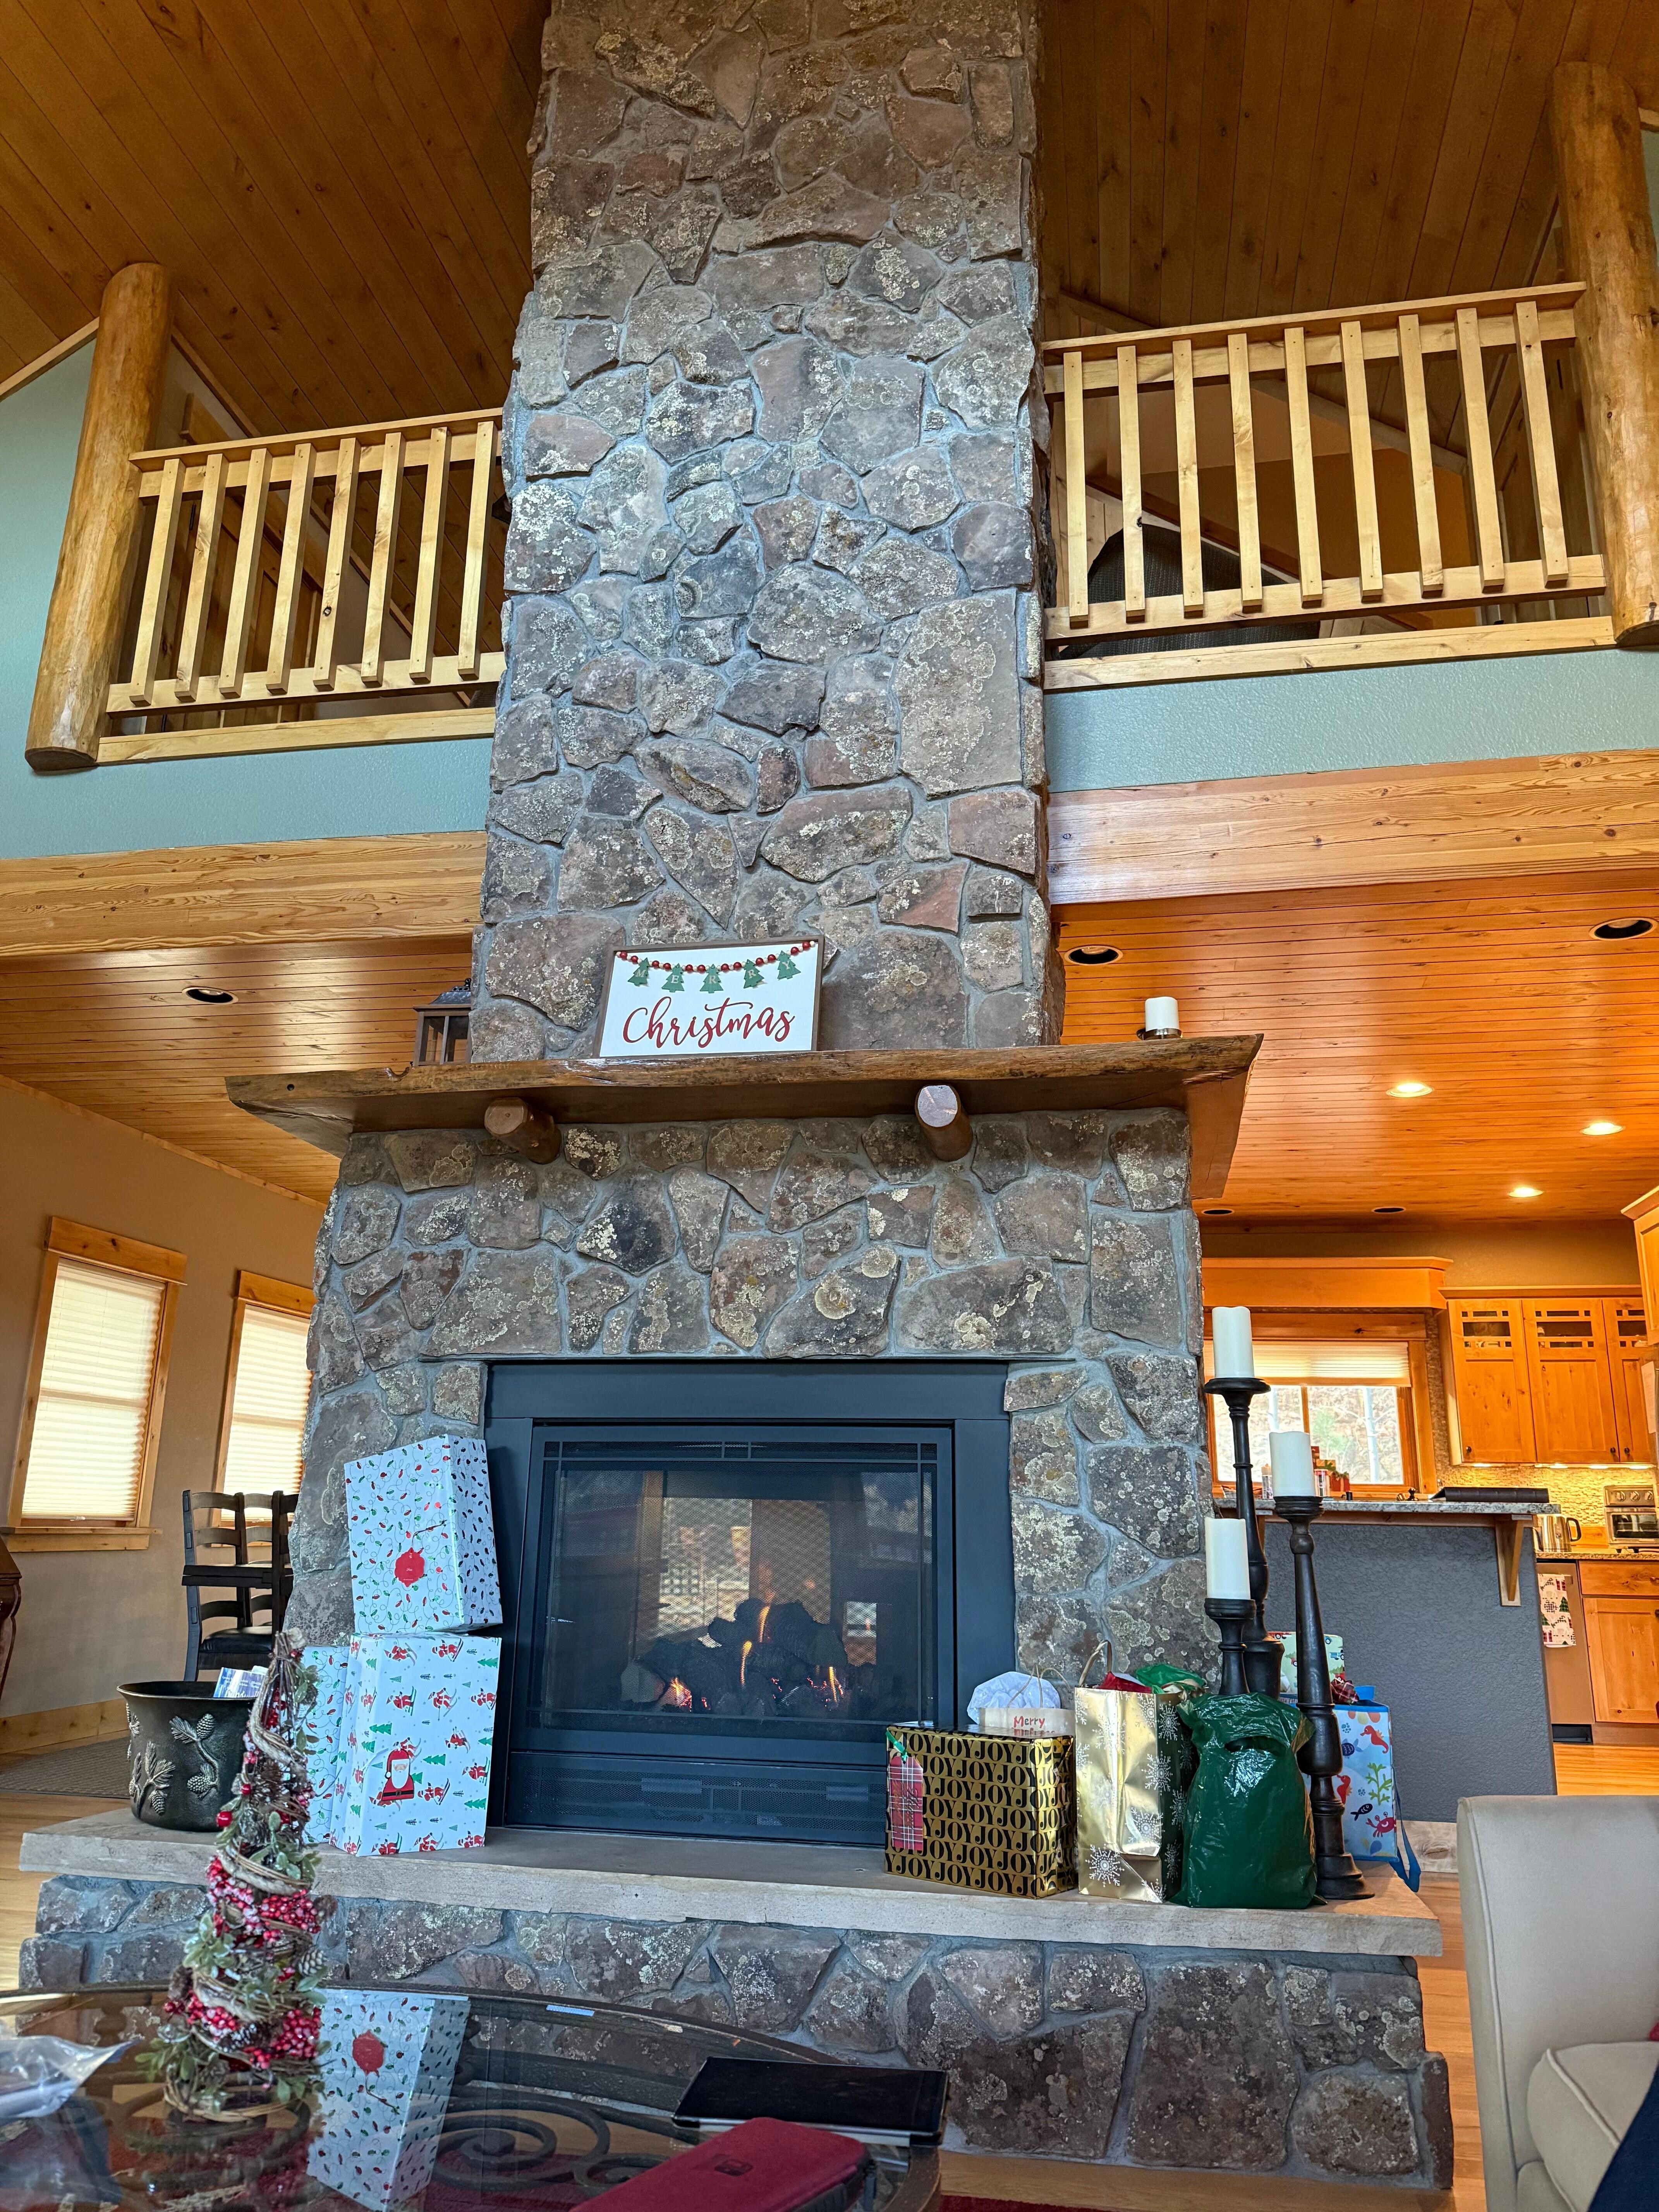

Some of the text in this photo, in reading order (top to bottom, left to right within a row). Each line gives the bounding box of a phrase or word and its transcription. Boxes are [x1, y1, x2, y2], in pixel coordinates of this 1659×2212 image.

[635, 961, 790, 984] MERRY
[623, 996, 795, 1048] Christmas
[1013, 1716, 1045, 1728] Merry
[935, 1736, 975, 1758] JOY
[974, 1741, 1015, 1763] JOY
[956, 1760, 997, 1782] JOY
[997, 1765, 1039, 1787] JOY
[934, 1778, 975, 1801] JOY
[975, 1783, 1015, 1806] JOY
[957, 1801, 997, 1825] JOY
[997, 1807, 1039, 1831] JOY
[935, 1820, 975, 1843] JOY
[975, 1826, 1016, 1850] JOY
[956, 1844, 997, 1869] JOY
[997, 1850, 1039, 1875] JOY
[896, 1855, 934, 1879] JOY
[934, 1862, 975, 1887] JOY
[975, 1869, 1016, 1894] JOY
